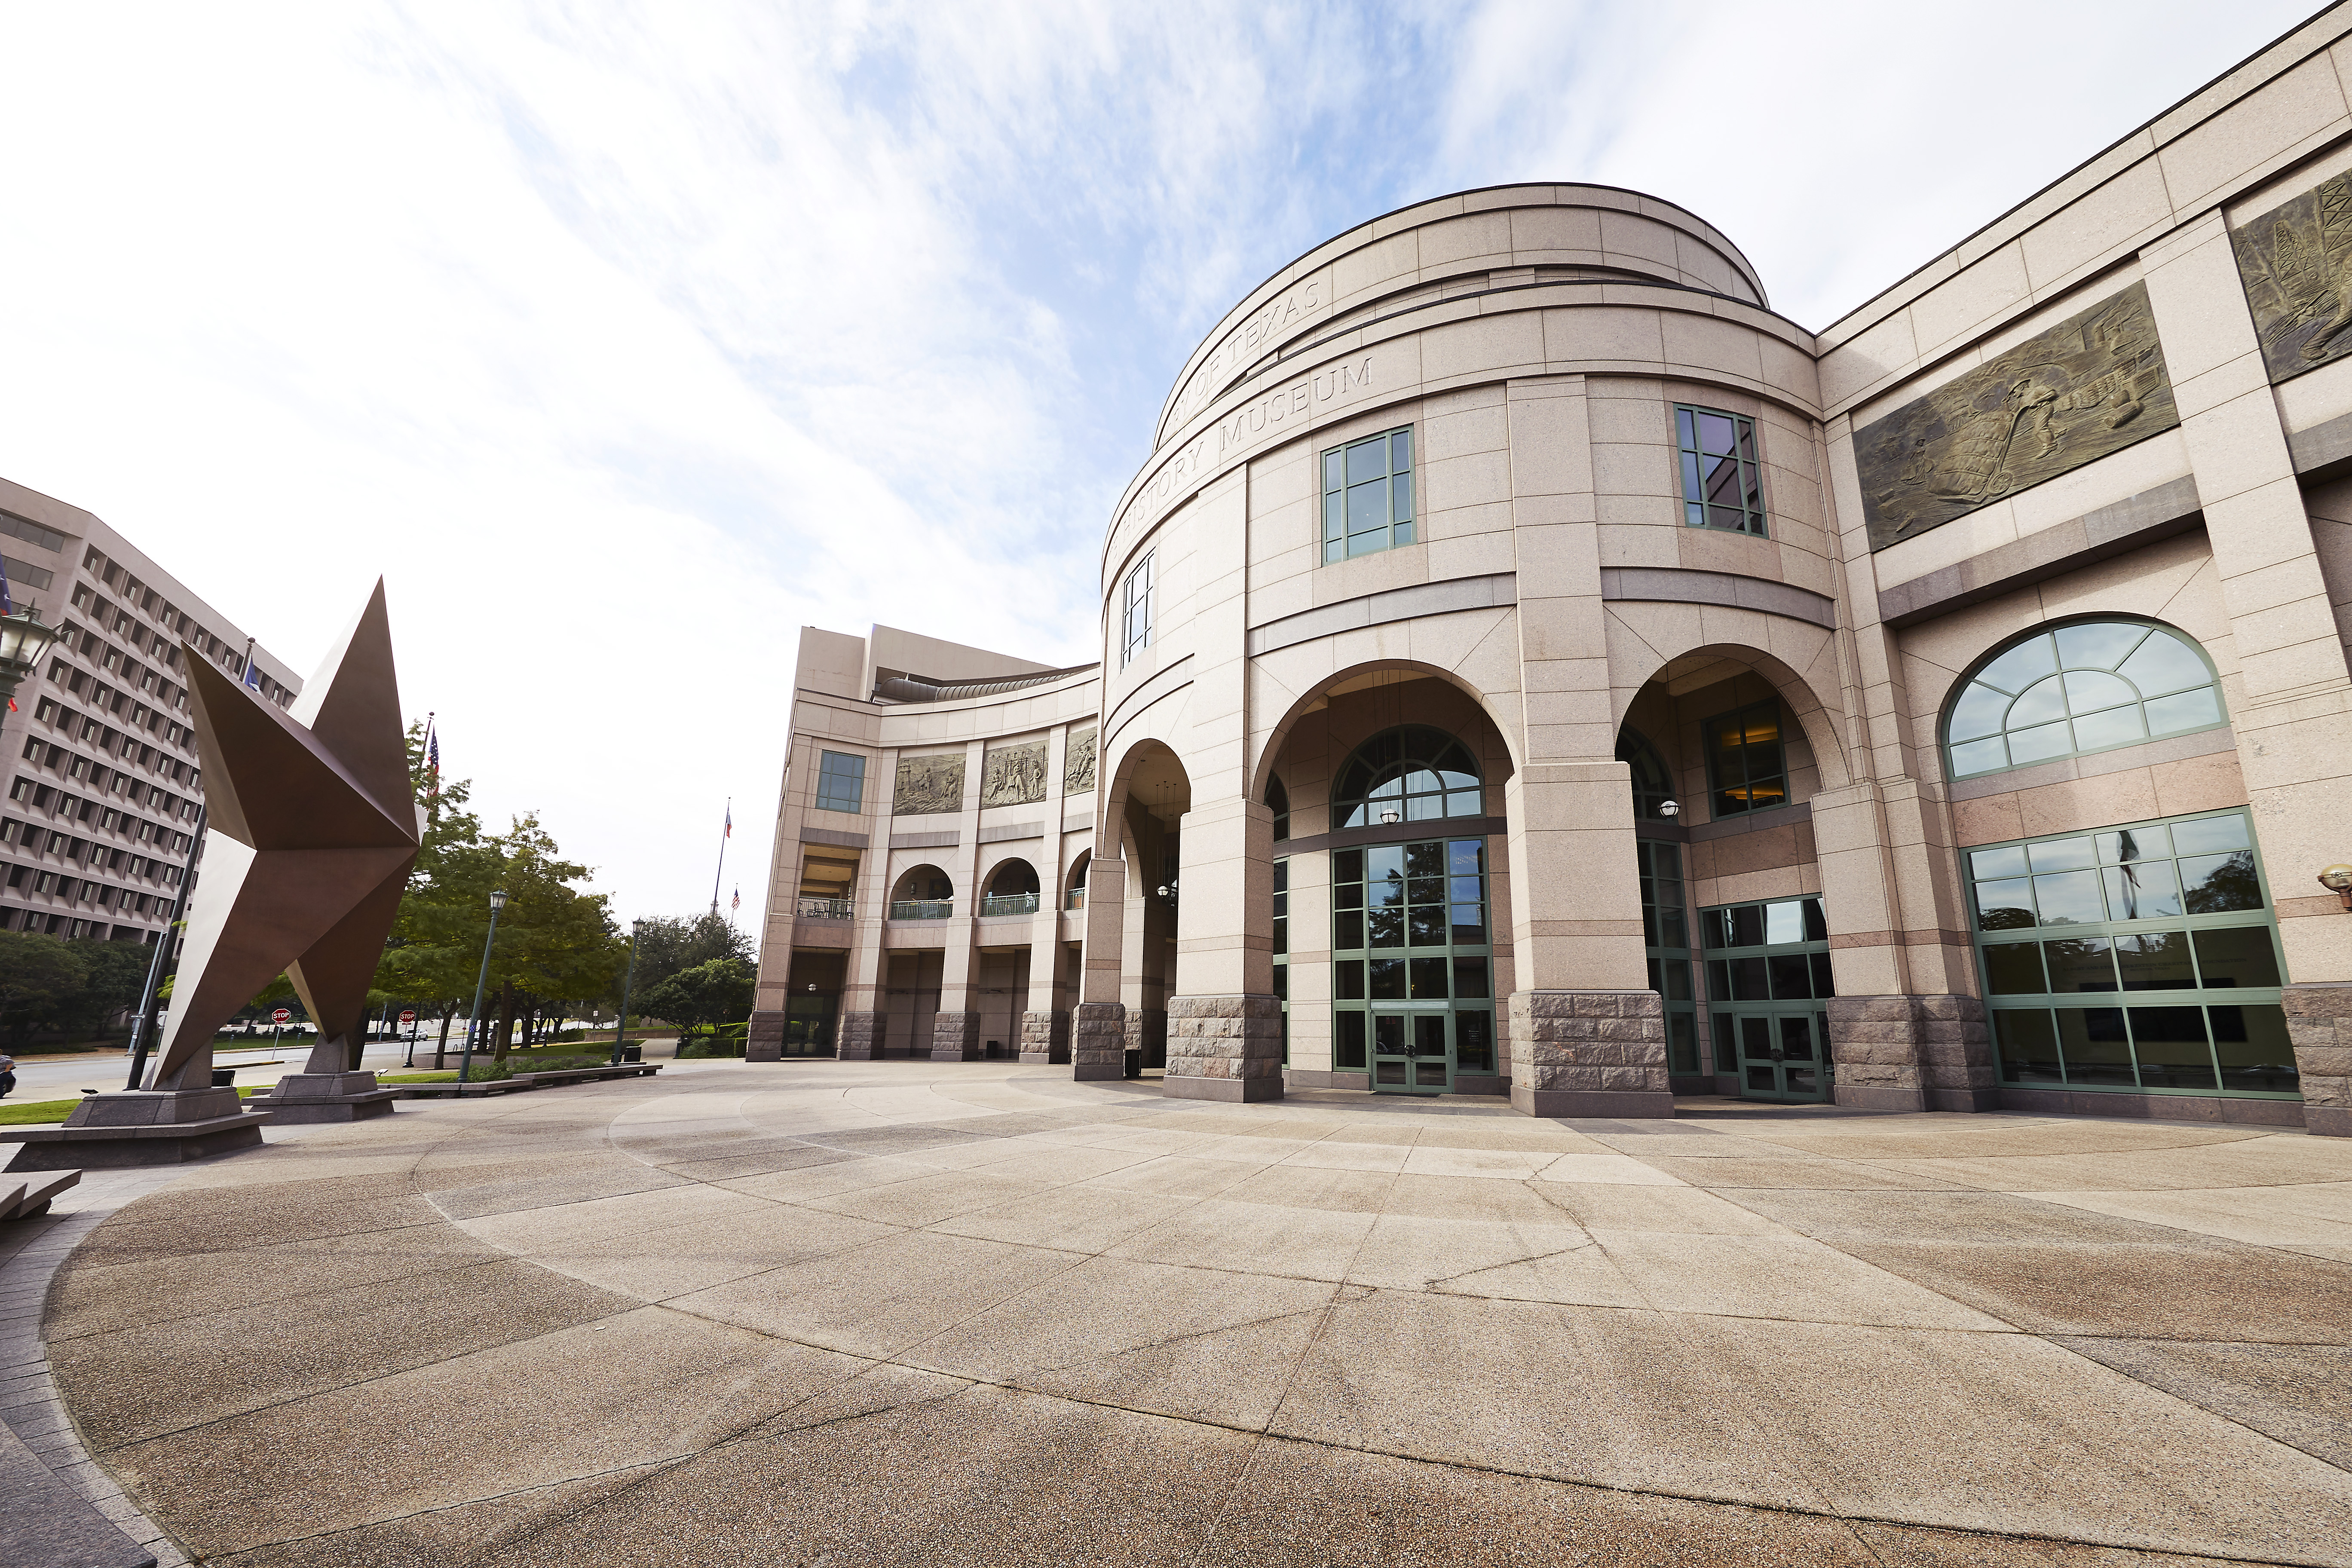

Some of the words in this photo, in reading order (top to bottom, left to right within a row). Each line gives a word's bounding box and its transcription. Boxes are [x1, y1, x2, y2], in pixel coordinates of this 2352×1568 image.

[1195, 355, 1221, 397] OF
[1228, 282, 1320, 362] TEXAS
[1123, 441, 1204, 543] HISTORY
[1221, 357, 1373, 451] MUSEUM
